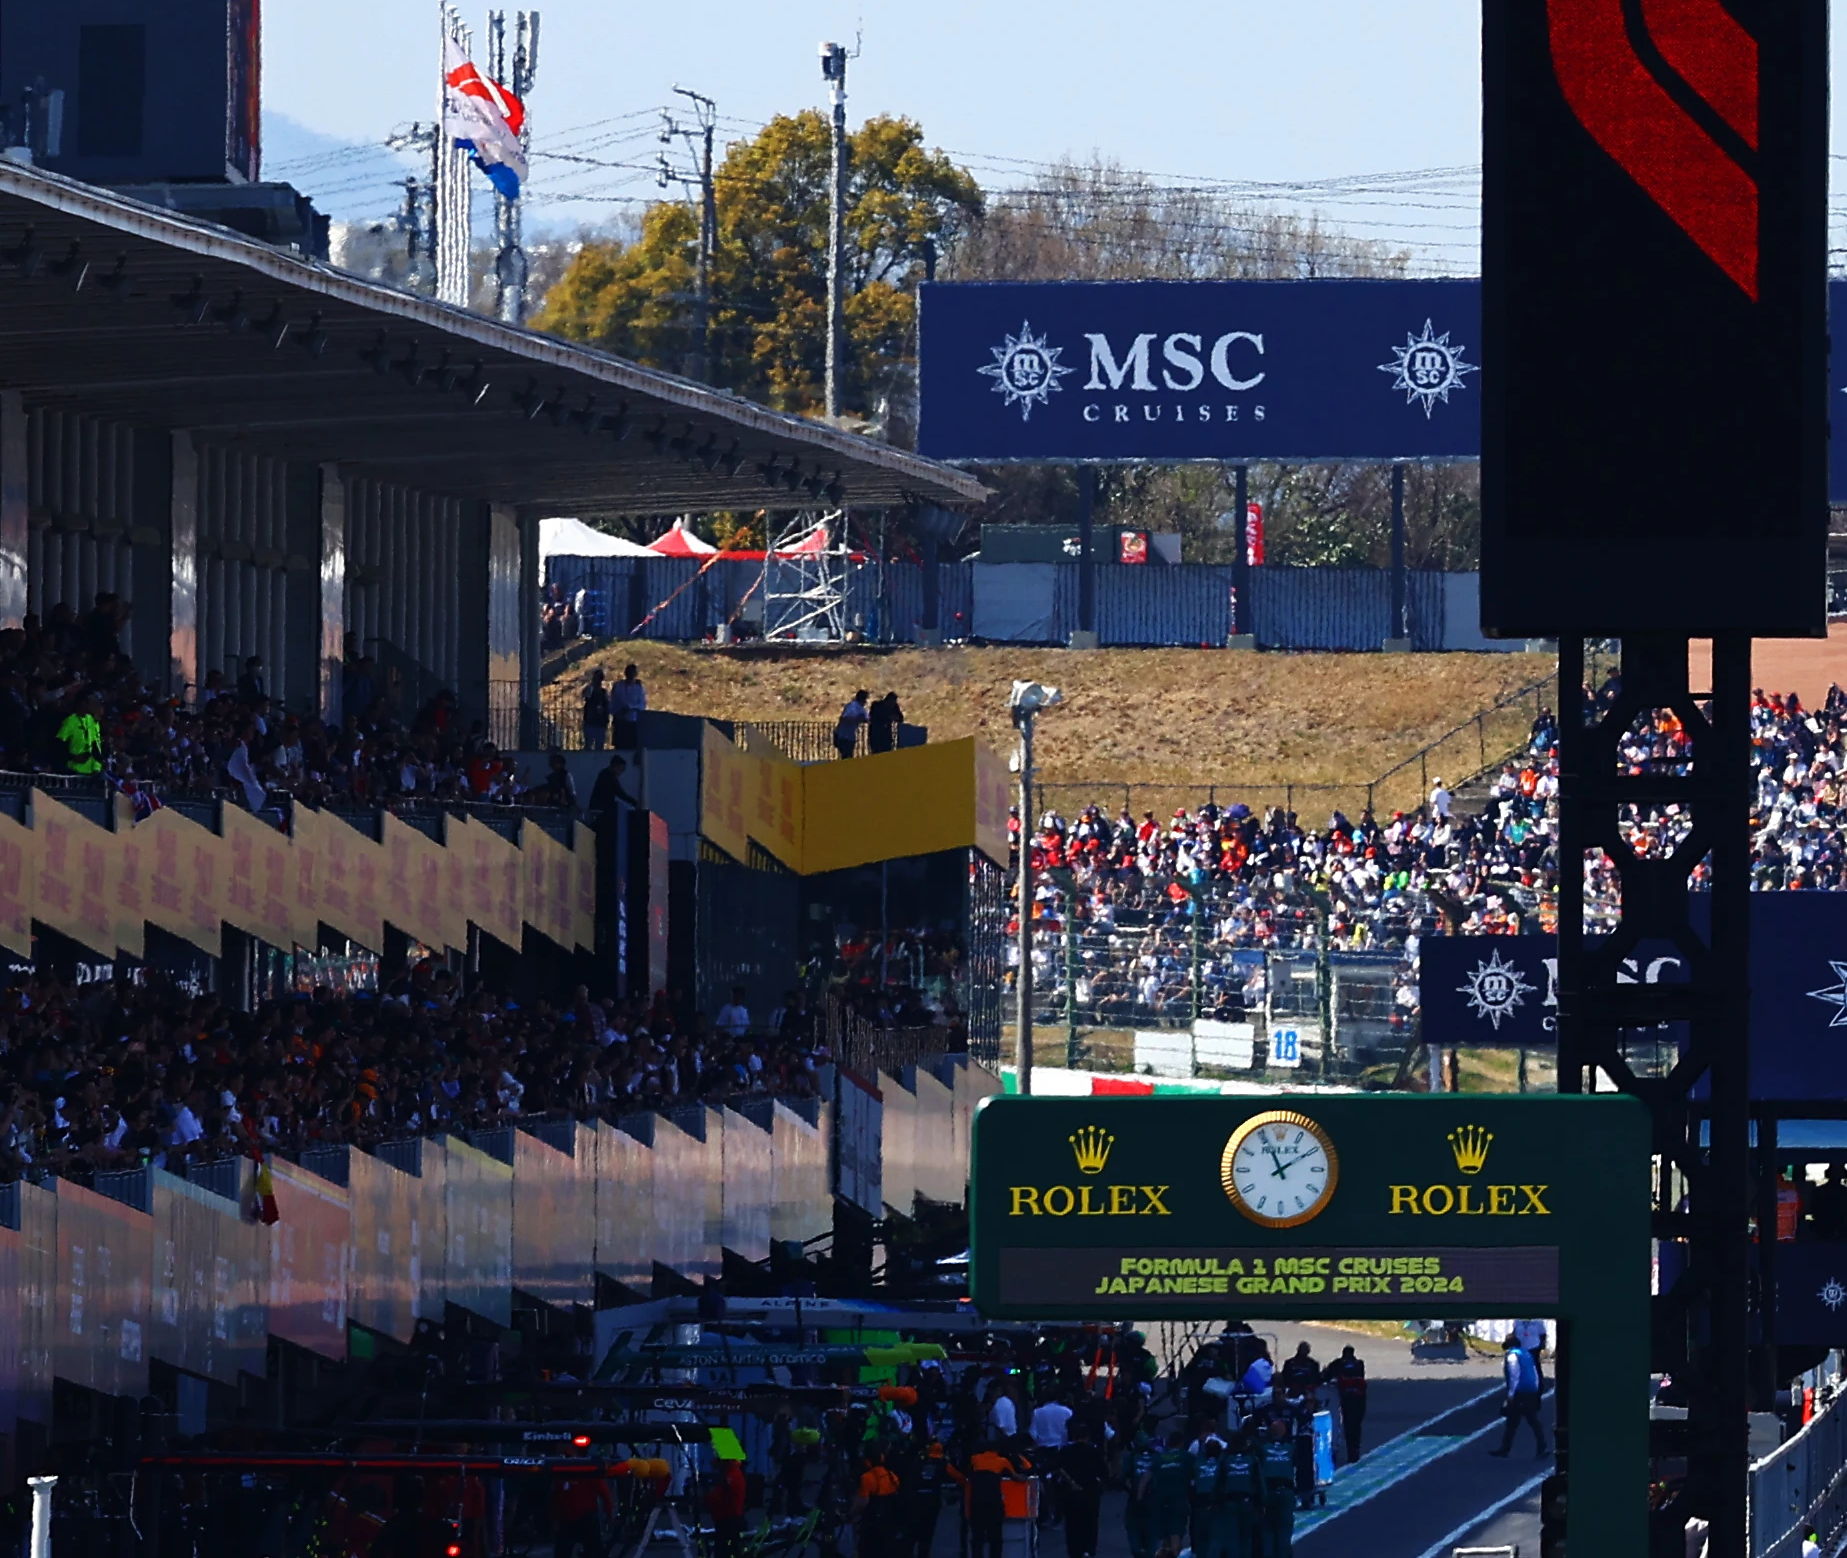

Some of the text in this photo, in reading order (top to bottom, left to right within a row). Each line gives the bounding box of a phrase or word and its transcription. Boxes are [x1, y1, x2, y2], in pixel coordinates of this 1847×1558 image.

[1083, 330, 1266, 392] MSC
[1083, 403, 1266, 423] CRUISES
[1273, 1028, 1299, 1060] 18
[1261, 1145, 1300, 1156] ROLEX
[1008, 1184, 1173, 1216] ROLEX
[1388, 1183, 1552, 1215] ROLEX
[1120, 1257, 1441, 1276] FORMULA 1 MSC CRUISES
[1094, 1276, 1465, 1295] JAPANESE GRAND PRIX 2024
